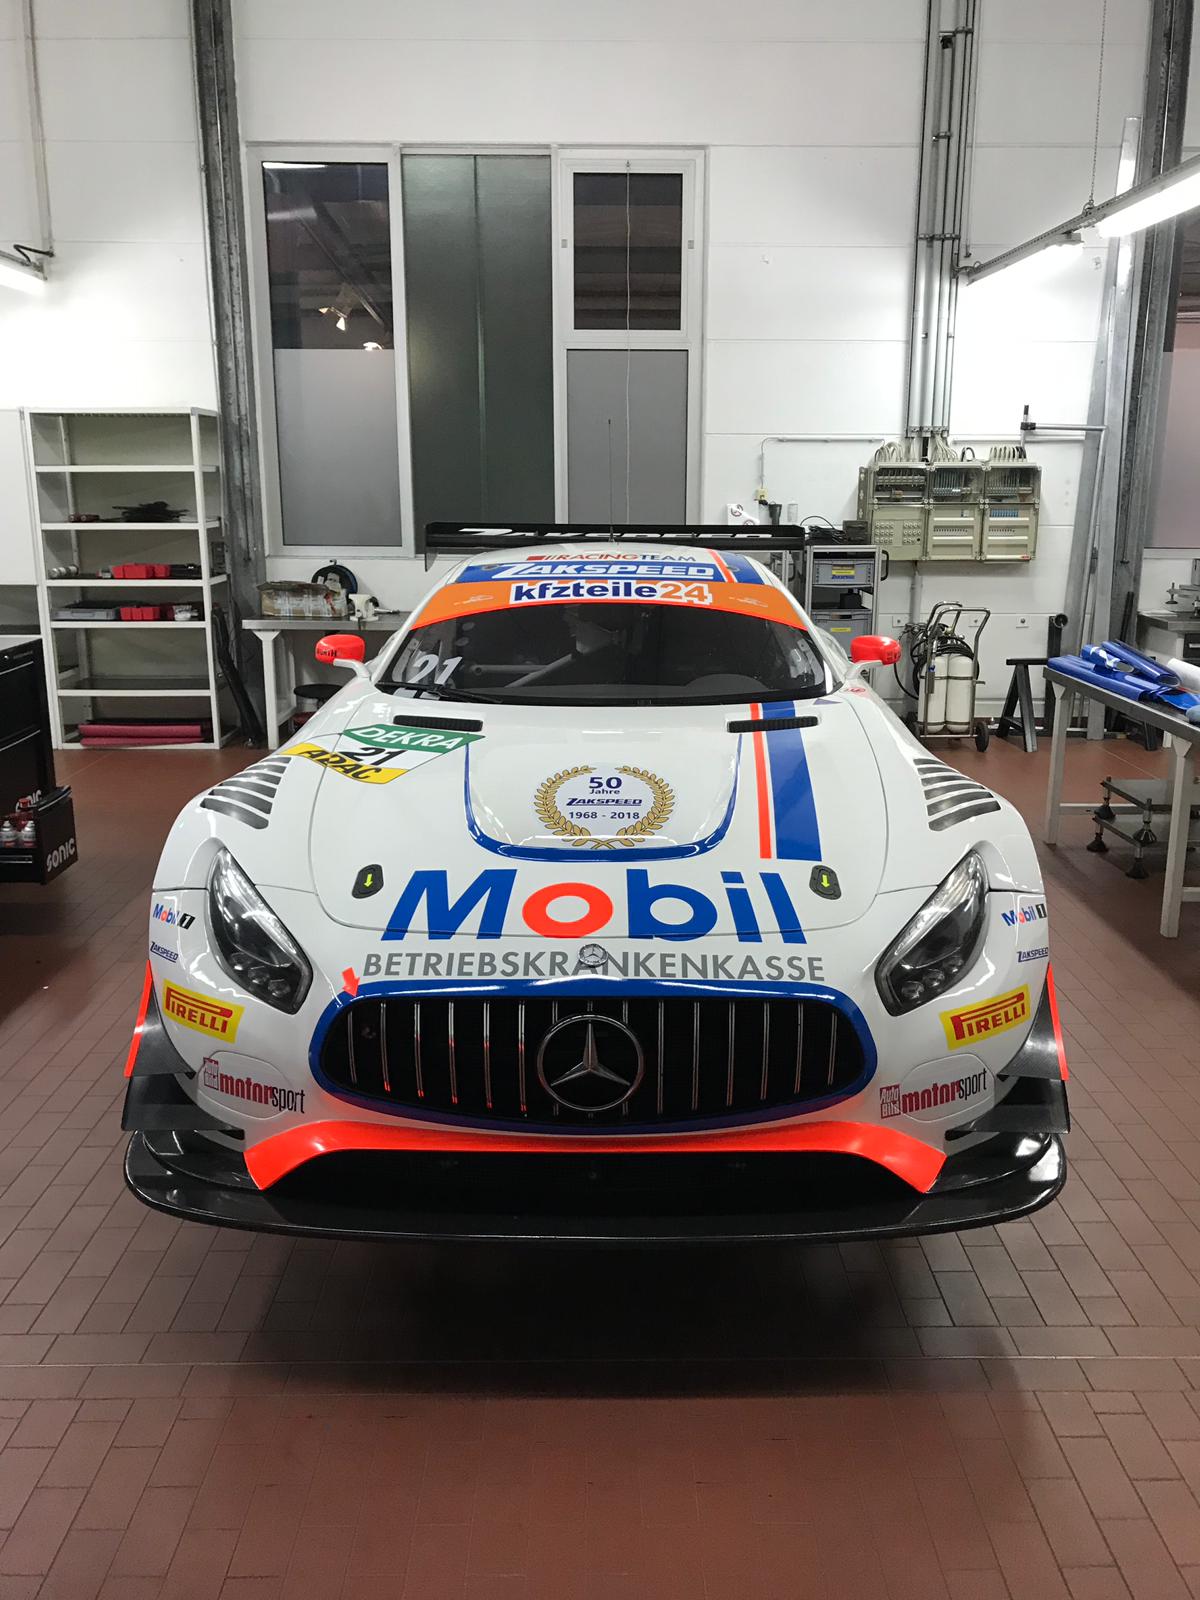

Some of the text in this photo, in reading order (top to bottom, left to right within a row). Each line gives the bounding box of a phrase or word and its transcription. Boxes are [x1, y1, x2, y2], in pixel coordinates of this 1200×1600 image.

[492, 563, 714, 579] ZAKSPEED
[513, 581, 708, 603] kfzteile24
[393, 654, 462, 700] 21
[351, 727, 464, 749] DEKRA
[297, 749, 382, 780] ADAC
[340, 747, 408, 766] 21
[589, 776, 623, 790] 50
[566, 797, 643, 807] ZAKSPEED
[568, 811, 598, 819] 1968
[610, 811, 640, 819] 2018
[381, 869, 807, 944] Mobil
[1001, 904, 1046, 927] Mobil 1
[150, 941, 179, 963] ZAKSPEED
[363, 951, 825, 981] BETRIEBSKRANKENKASSE
[165, 986, 234, 1034] PIRELLI
[950, 992, 1026, 1041] PIRELLI
[219, 1072, 306, 1114] motorsport
[901, 1068, 987, 1115] motorsport
